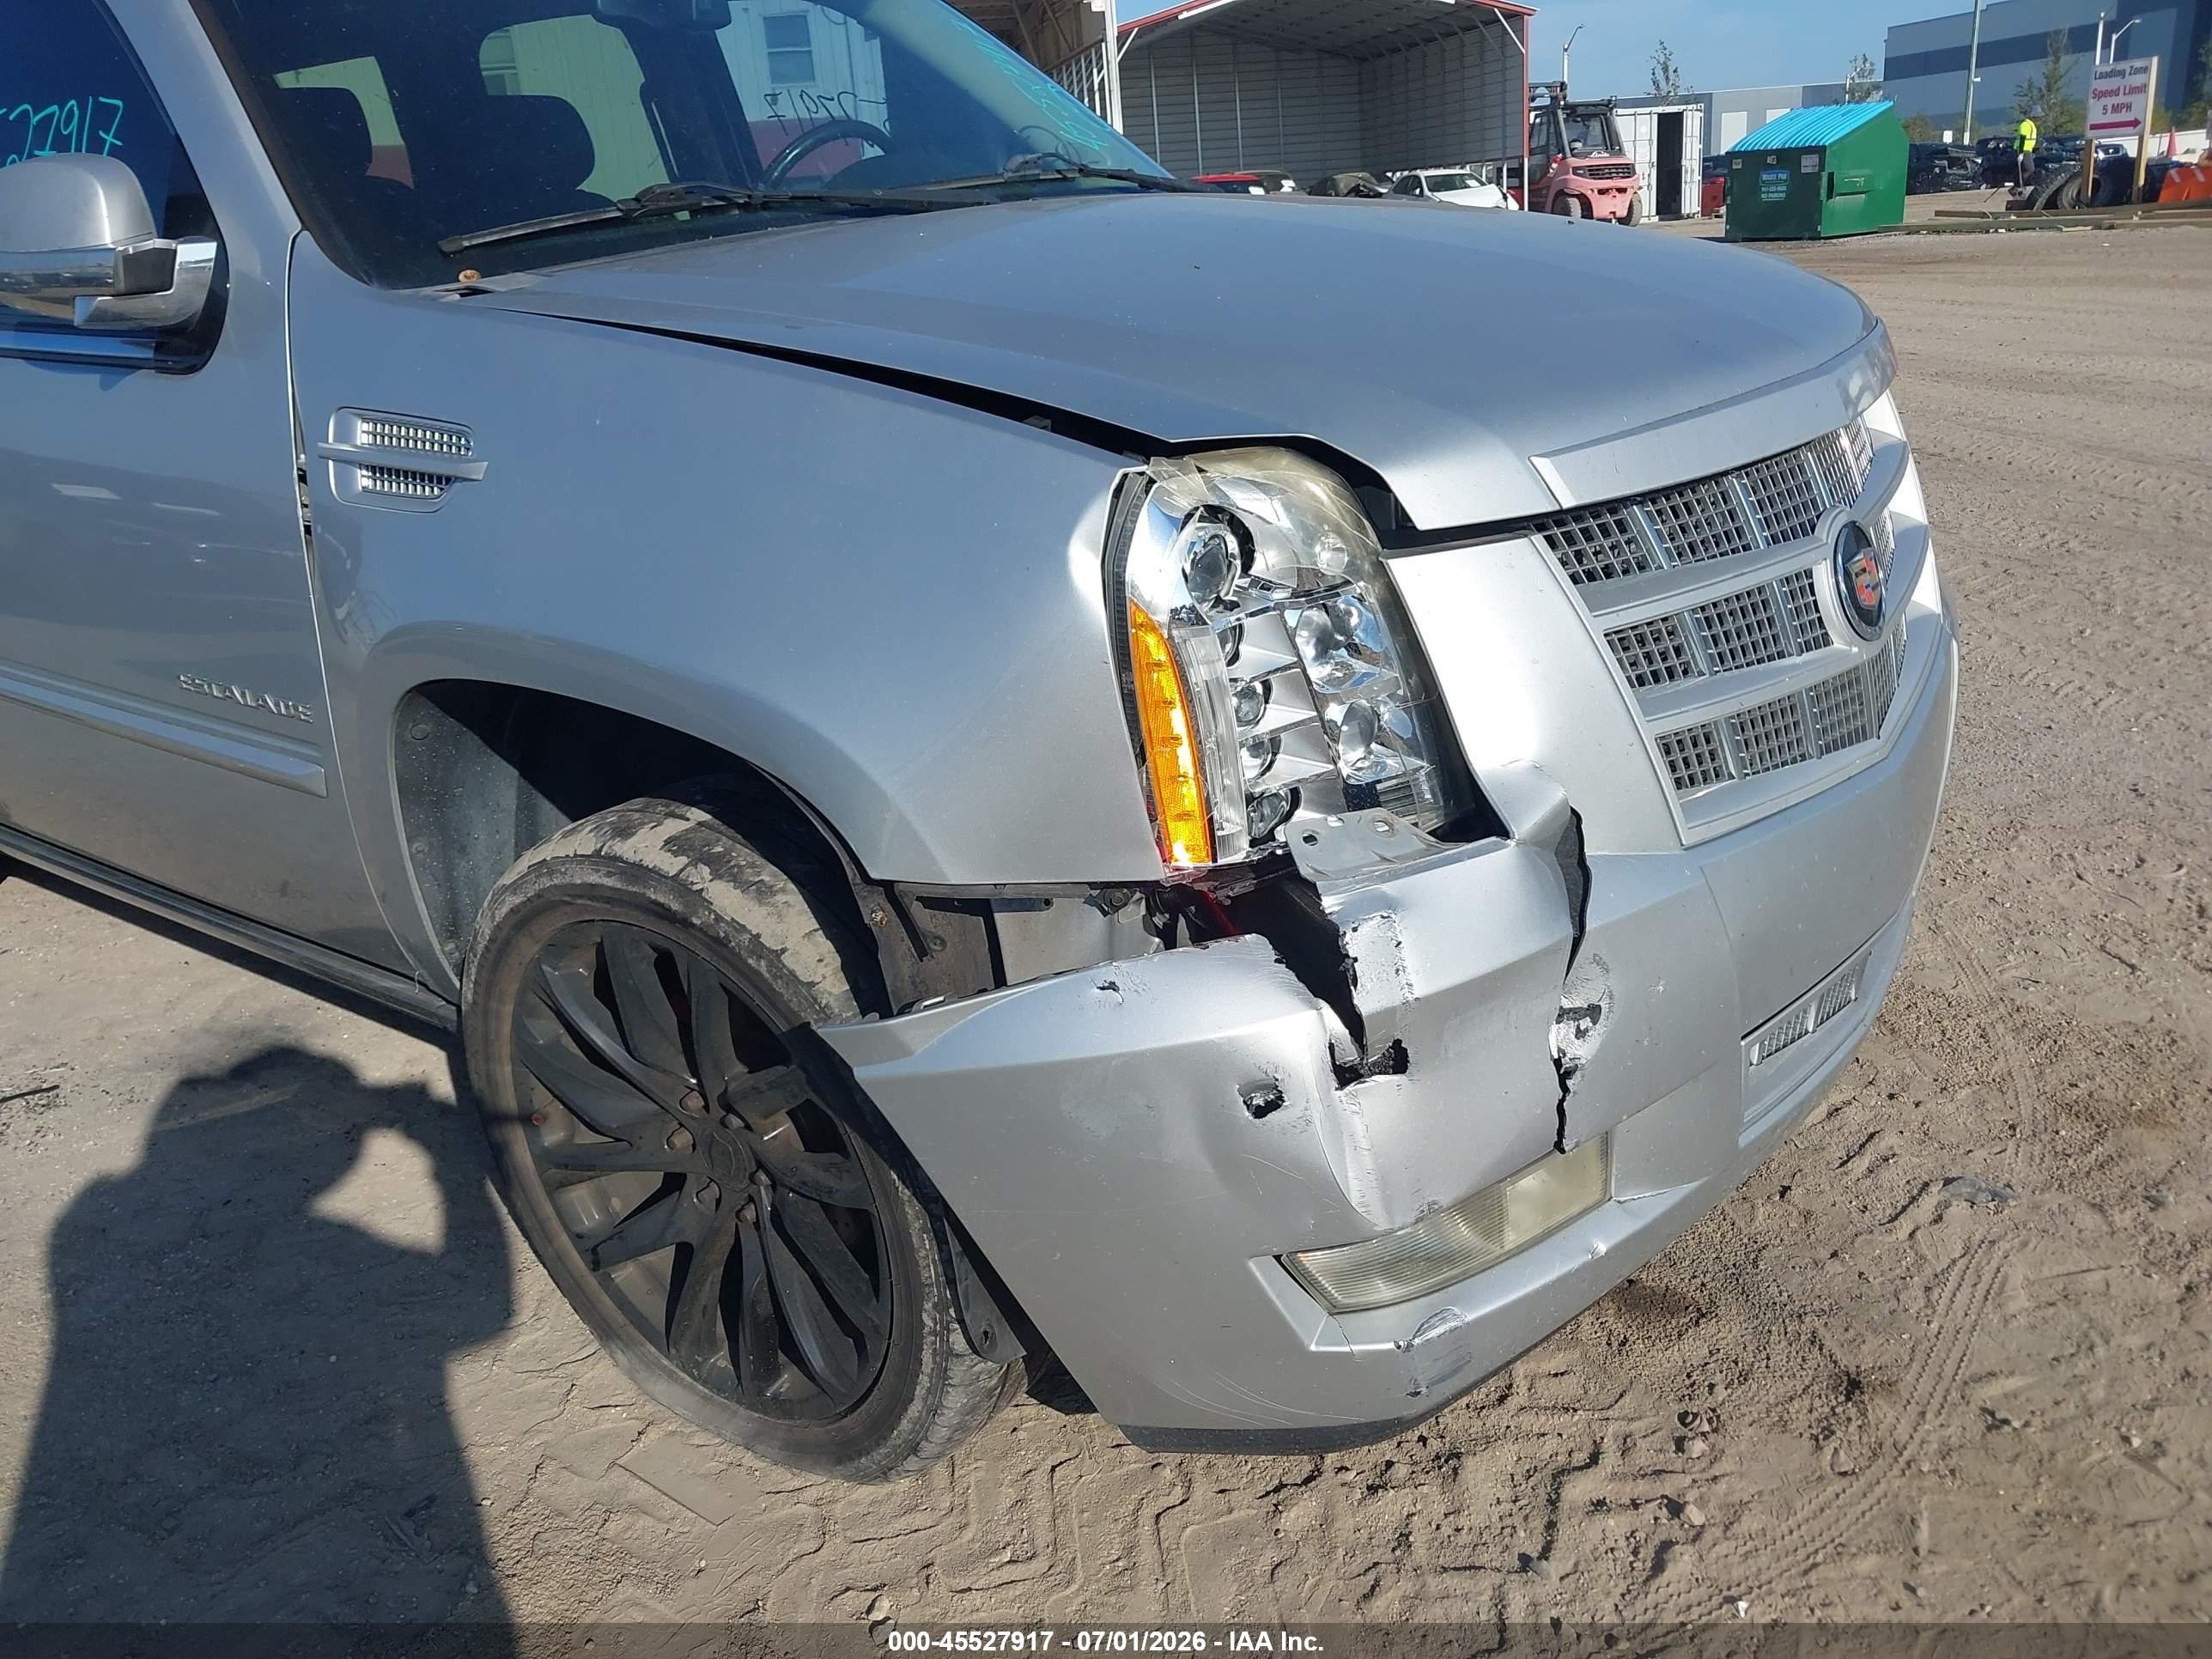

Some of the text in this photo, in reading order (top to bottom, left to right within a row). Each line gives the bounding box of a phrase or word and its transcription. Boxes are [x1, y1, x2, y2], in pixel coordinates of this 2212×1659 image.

[2094, 65, 2149, 80] Loading Zone
[2092, 82, 2148, 101] Speed Limit
[2101, 102, 2133, 115] 5 MPH
[178, 673, 315, 725] ESCALADE
